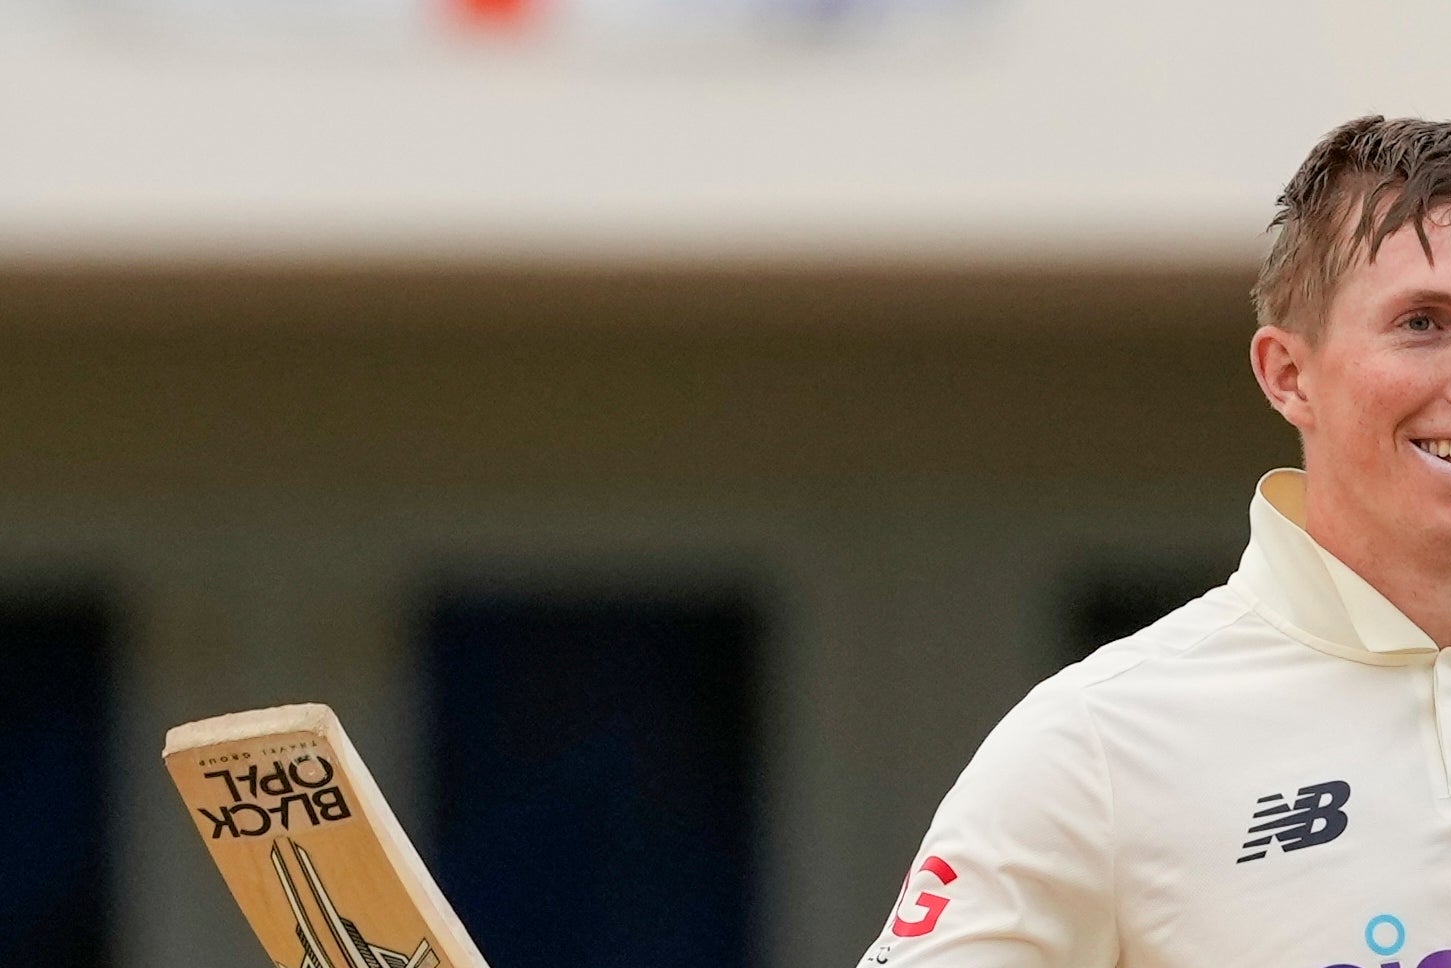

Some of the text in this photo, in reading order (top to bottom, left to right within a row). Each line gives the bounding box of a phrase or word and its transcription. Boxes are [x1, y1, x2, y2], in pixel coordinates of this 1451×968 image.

[199, 752, 251, 767] GROUP
[204, 755, 334, 802] OPAL
[197, 785, 352, 839] BLACK
[1236, 780, 1351, 864] NB
